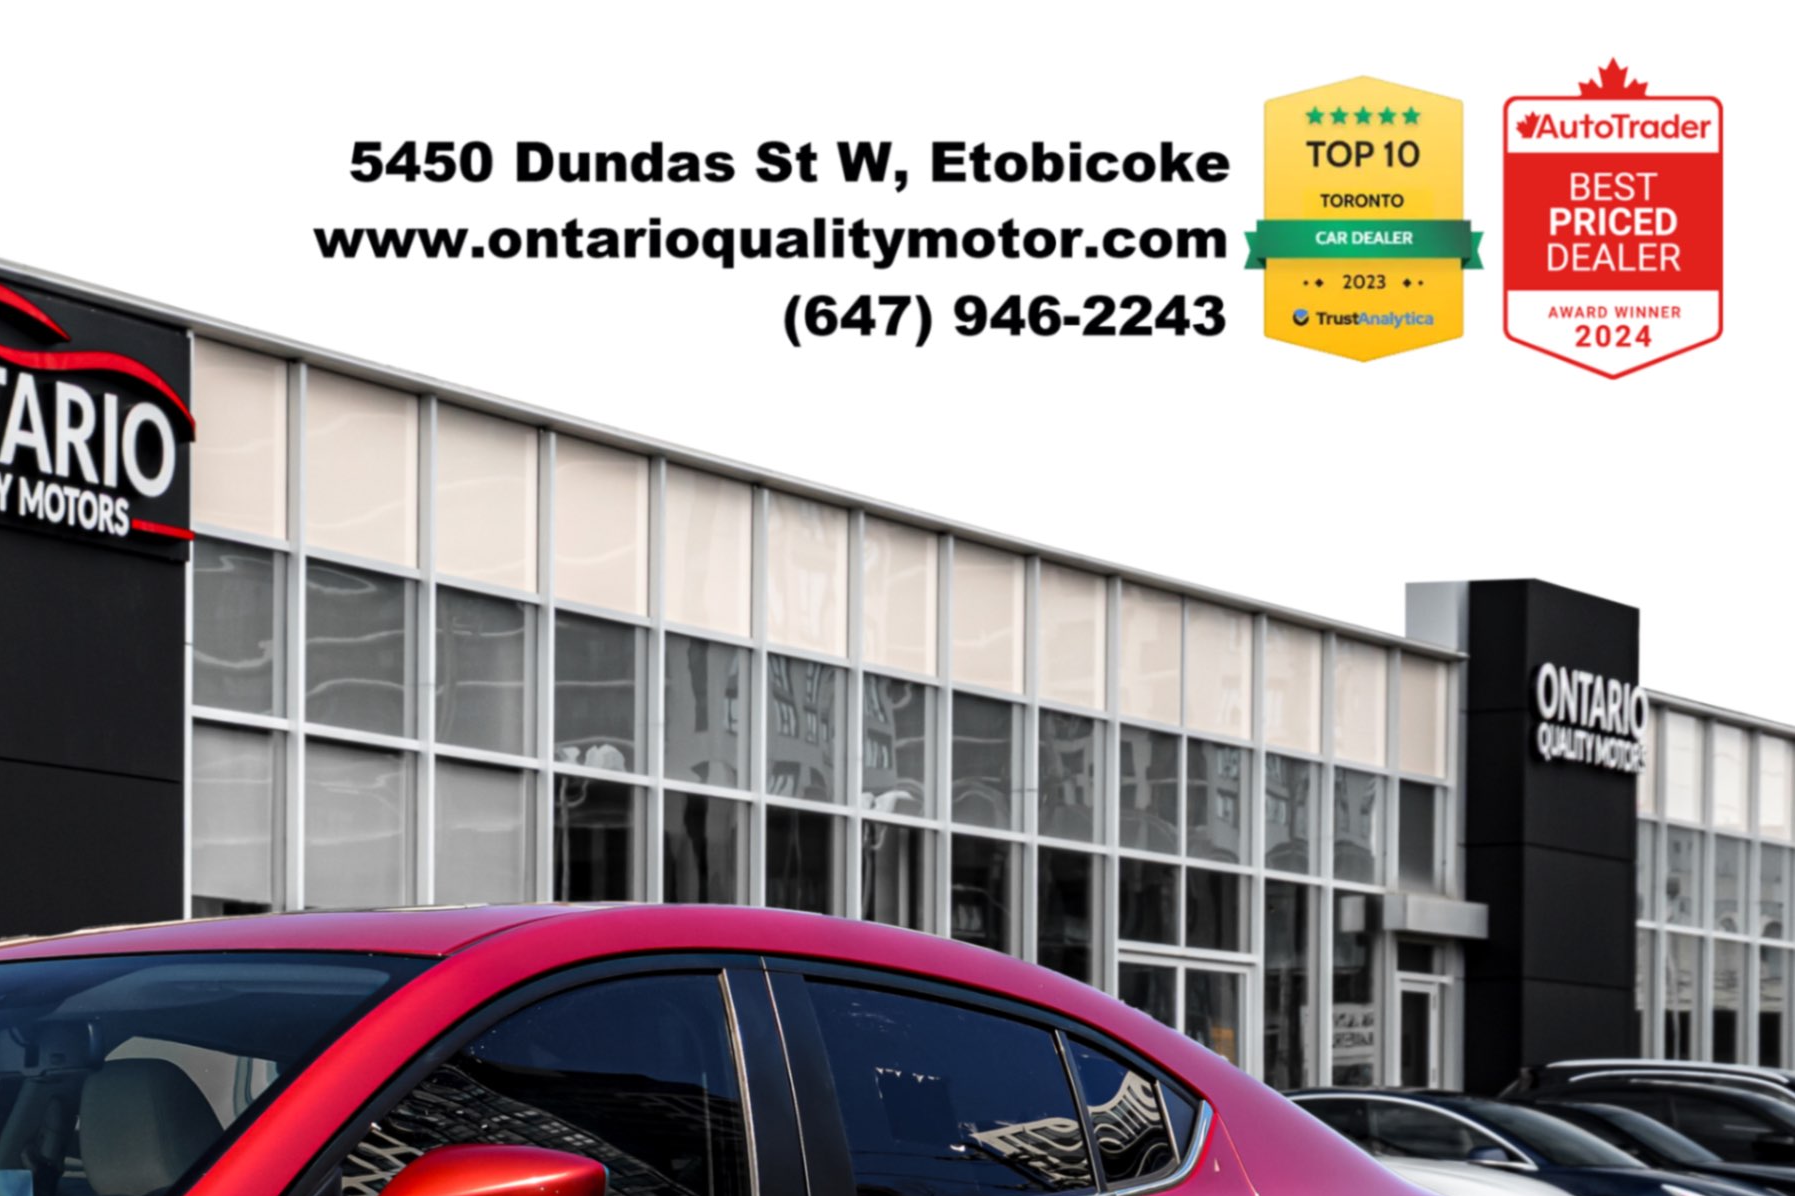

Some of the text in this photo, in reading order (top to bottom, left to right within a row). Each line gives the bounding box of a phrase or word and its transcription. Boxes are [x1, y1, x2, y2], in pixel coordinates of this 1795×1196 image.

[19, 477, 130, 536] MOTORS
[1537, 662, 1648, 740] ONTARIO
[1537, 722, 1594, 763] QUALITY
